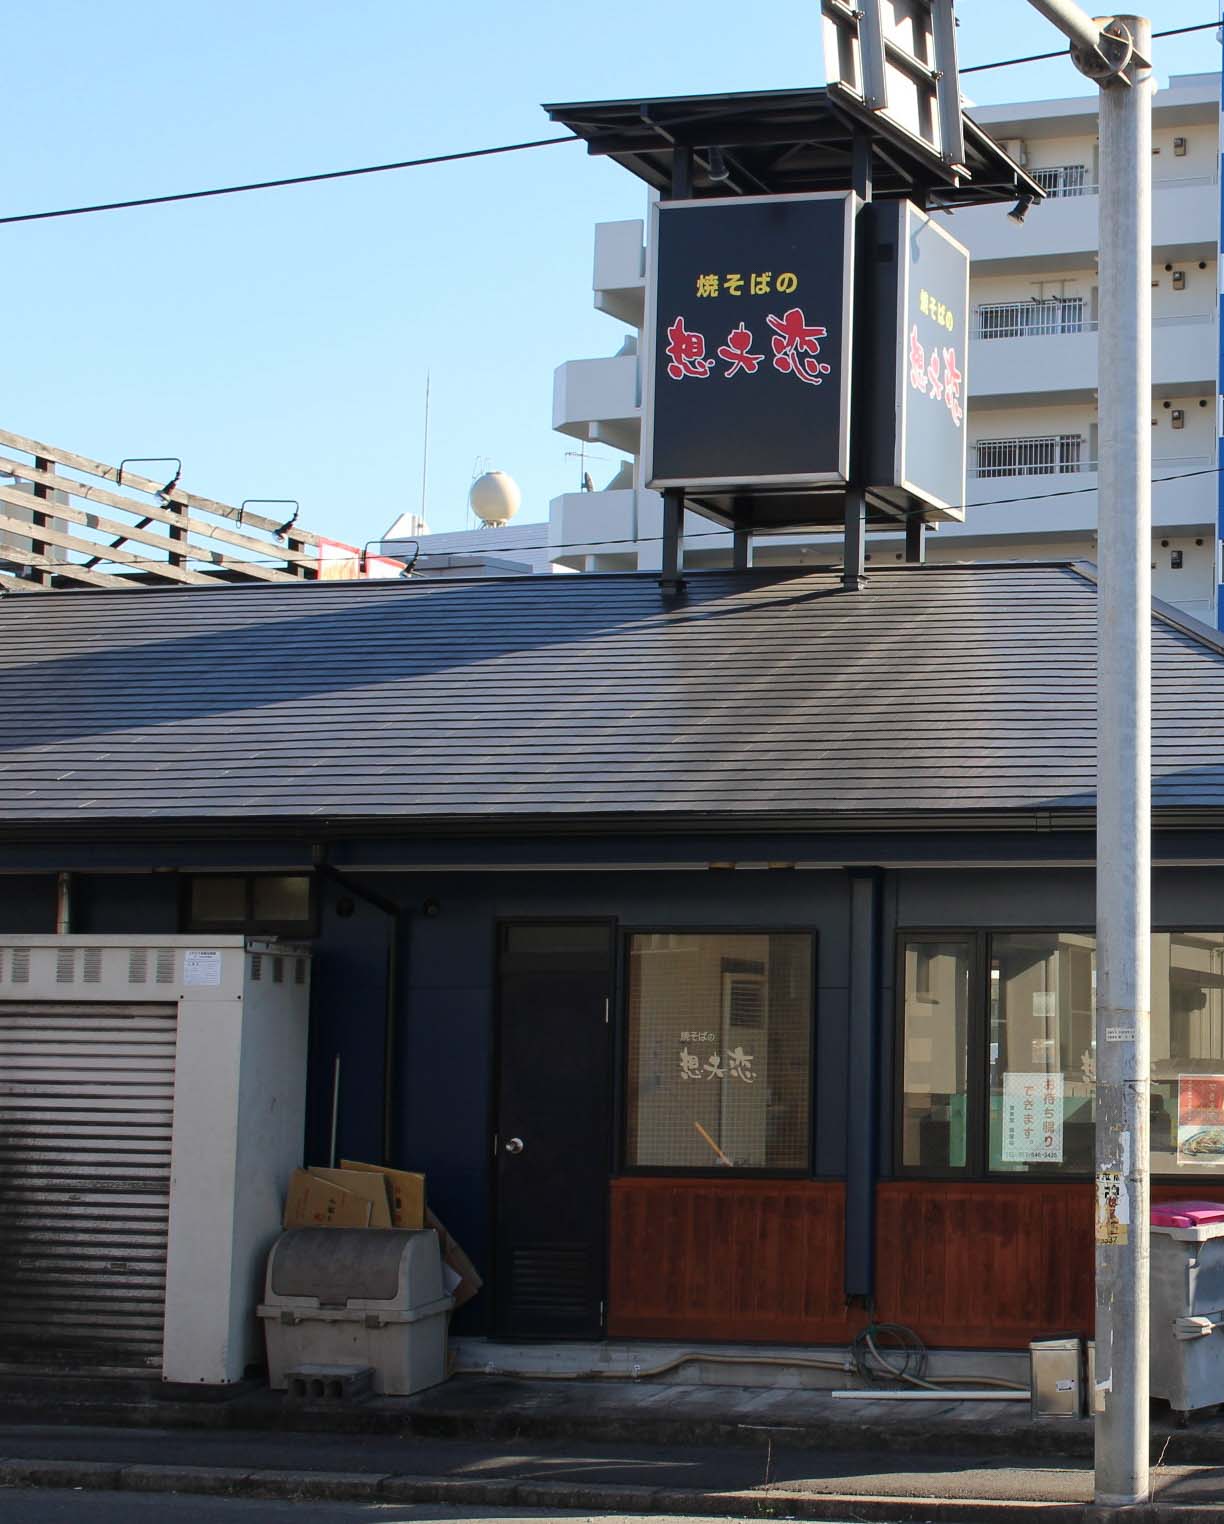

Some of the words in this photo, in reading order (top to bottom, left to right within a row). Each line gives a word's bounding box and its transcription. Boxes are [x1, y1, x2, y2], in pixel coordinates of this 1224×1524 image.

[696, 272, 799, 298] 焼そばの
[1042, 1077, 1057, 1148] お持ち帰り
